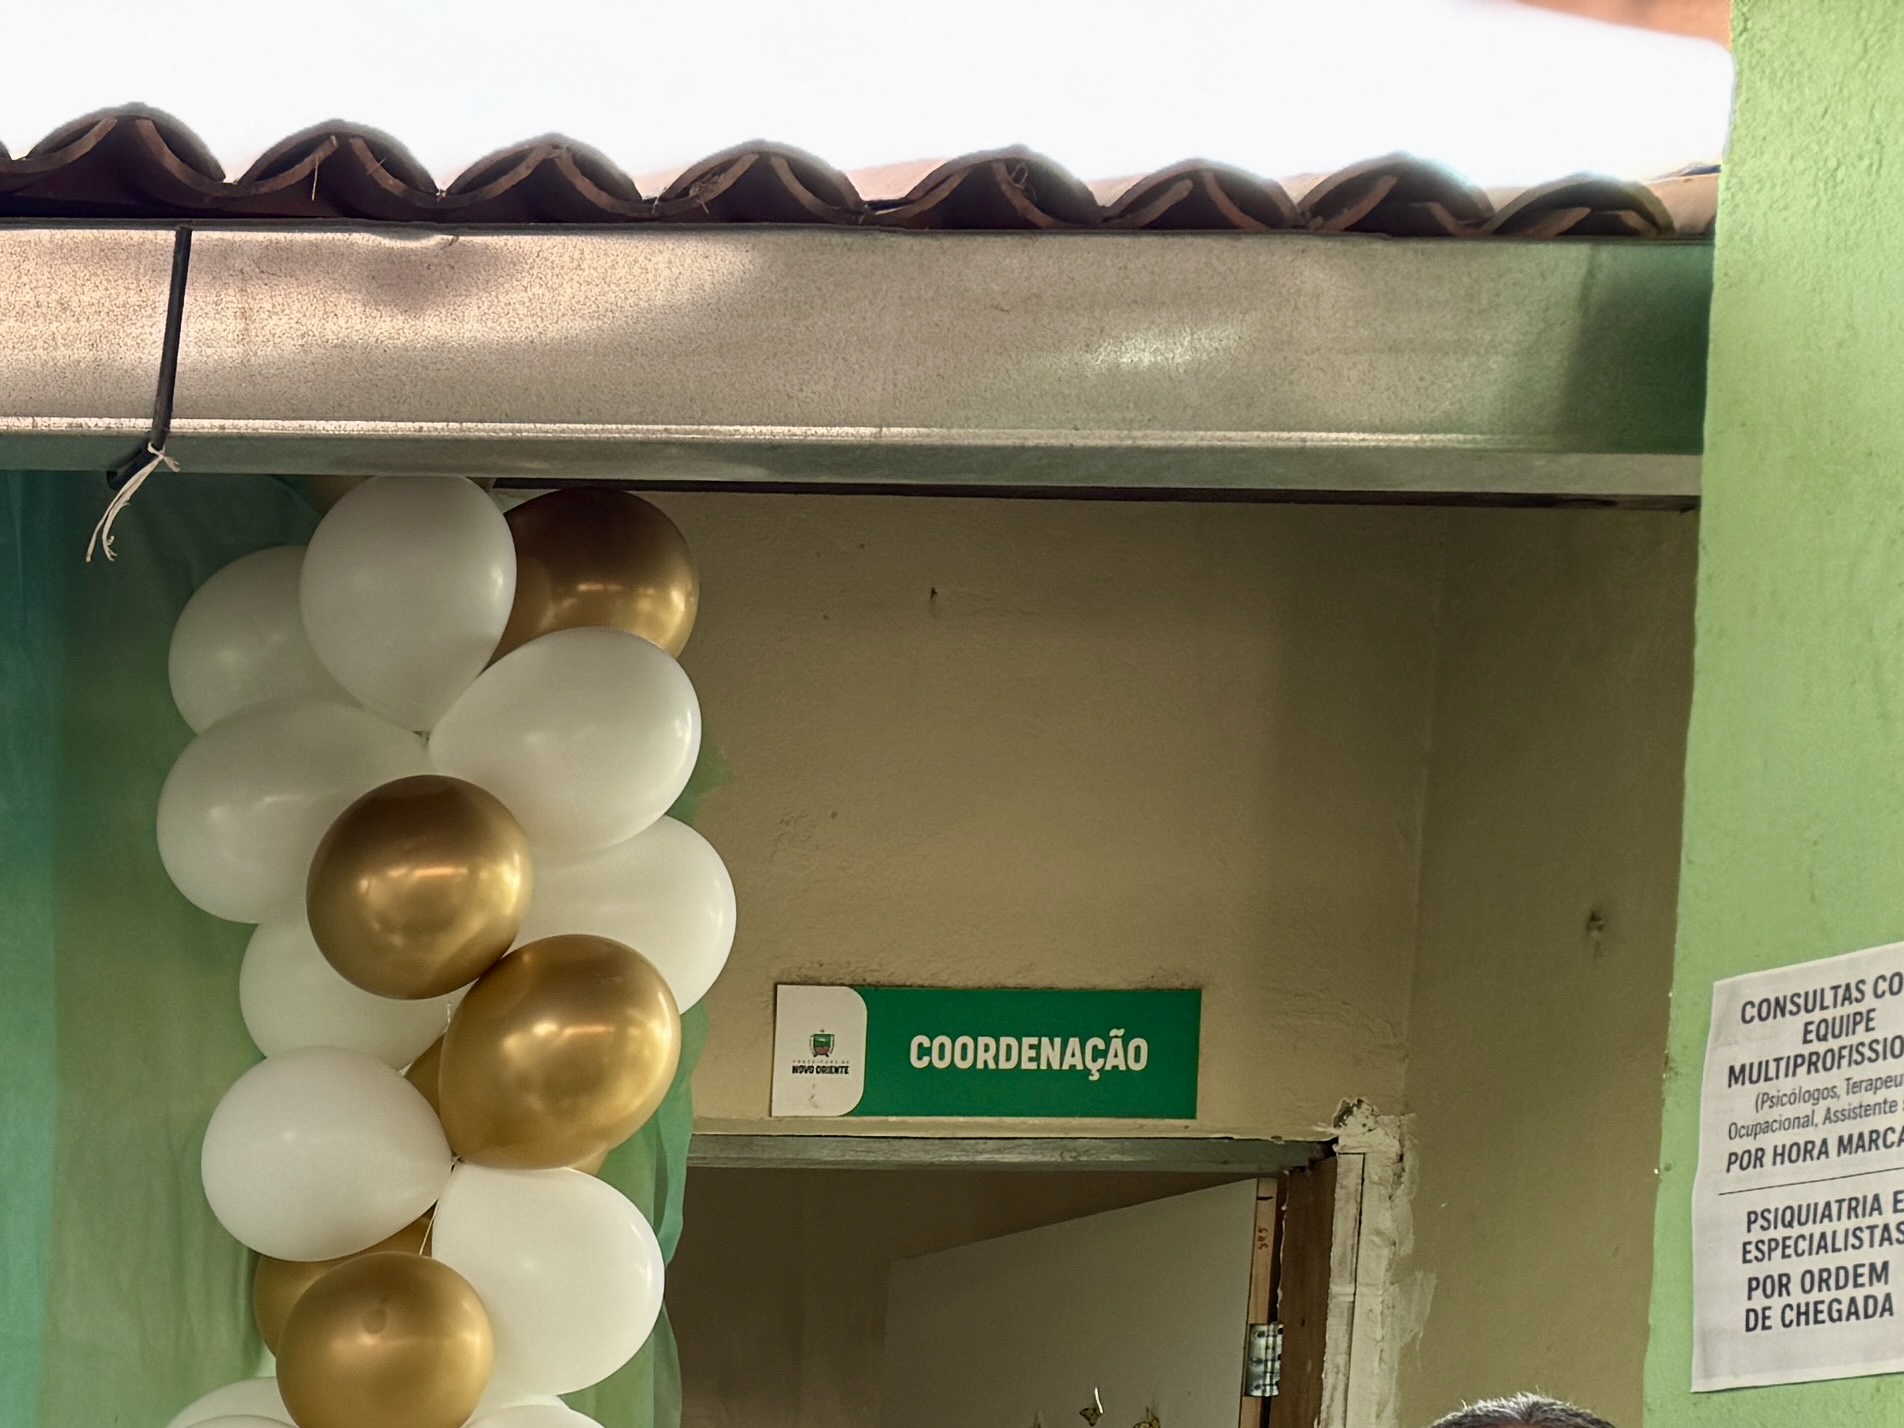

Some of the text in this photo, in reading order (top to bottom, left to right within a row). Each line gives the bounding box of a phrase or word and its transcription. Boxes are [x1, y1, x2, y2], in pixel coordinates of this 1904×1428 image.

[1741, 979, 1866, 1024] CONSULTAS
[1802, 1008, 1877, 1045] EQUIPE
[909, 1028, 1148, 1081] COORDENAÇÃO
[1728, 1034, 1904, 1088] MULTIPROFISSIO
[1728, 1098, 1898, 1141] Ocupacional, Assistente
[1755, 1085, 1841, 1114] (Psicólogos,
[1726, 1147, 1766, 1174] POR
[1772, 1137, 1830, 1167] HORA
[1747, 1189, 1904, 1233] PSIQUIATRIA E
[1742, 1220, 1904, 1264] ESPECIALISTAS
[1747, 1260, 1890, 1301] POR ORDEM
[1745, 1292, 1894, 1332] DE CHEGADA
